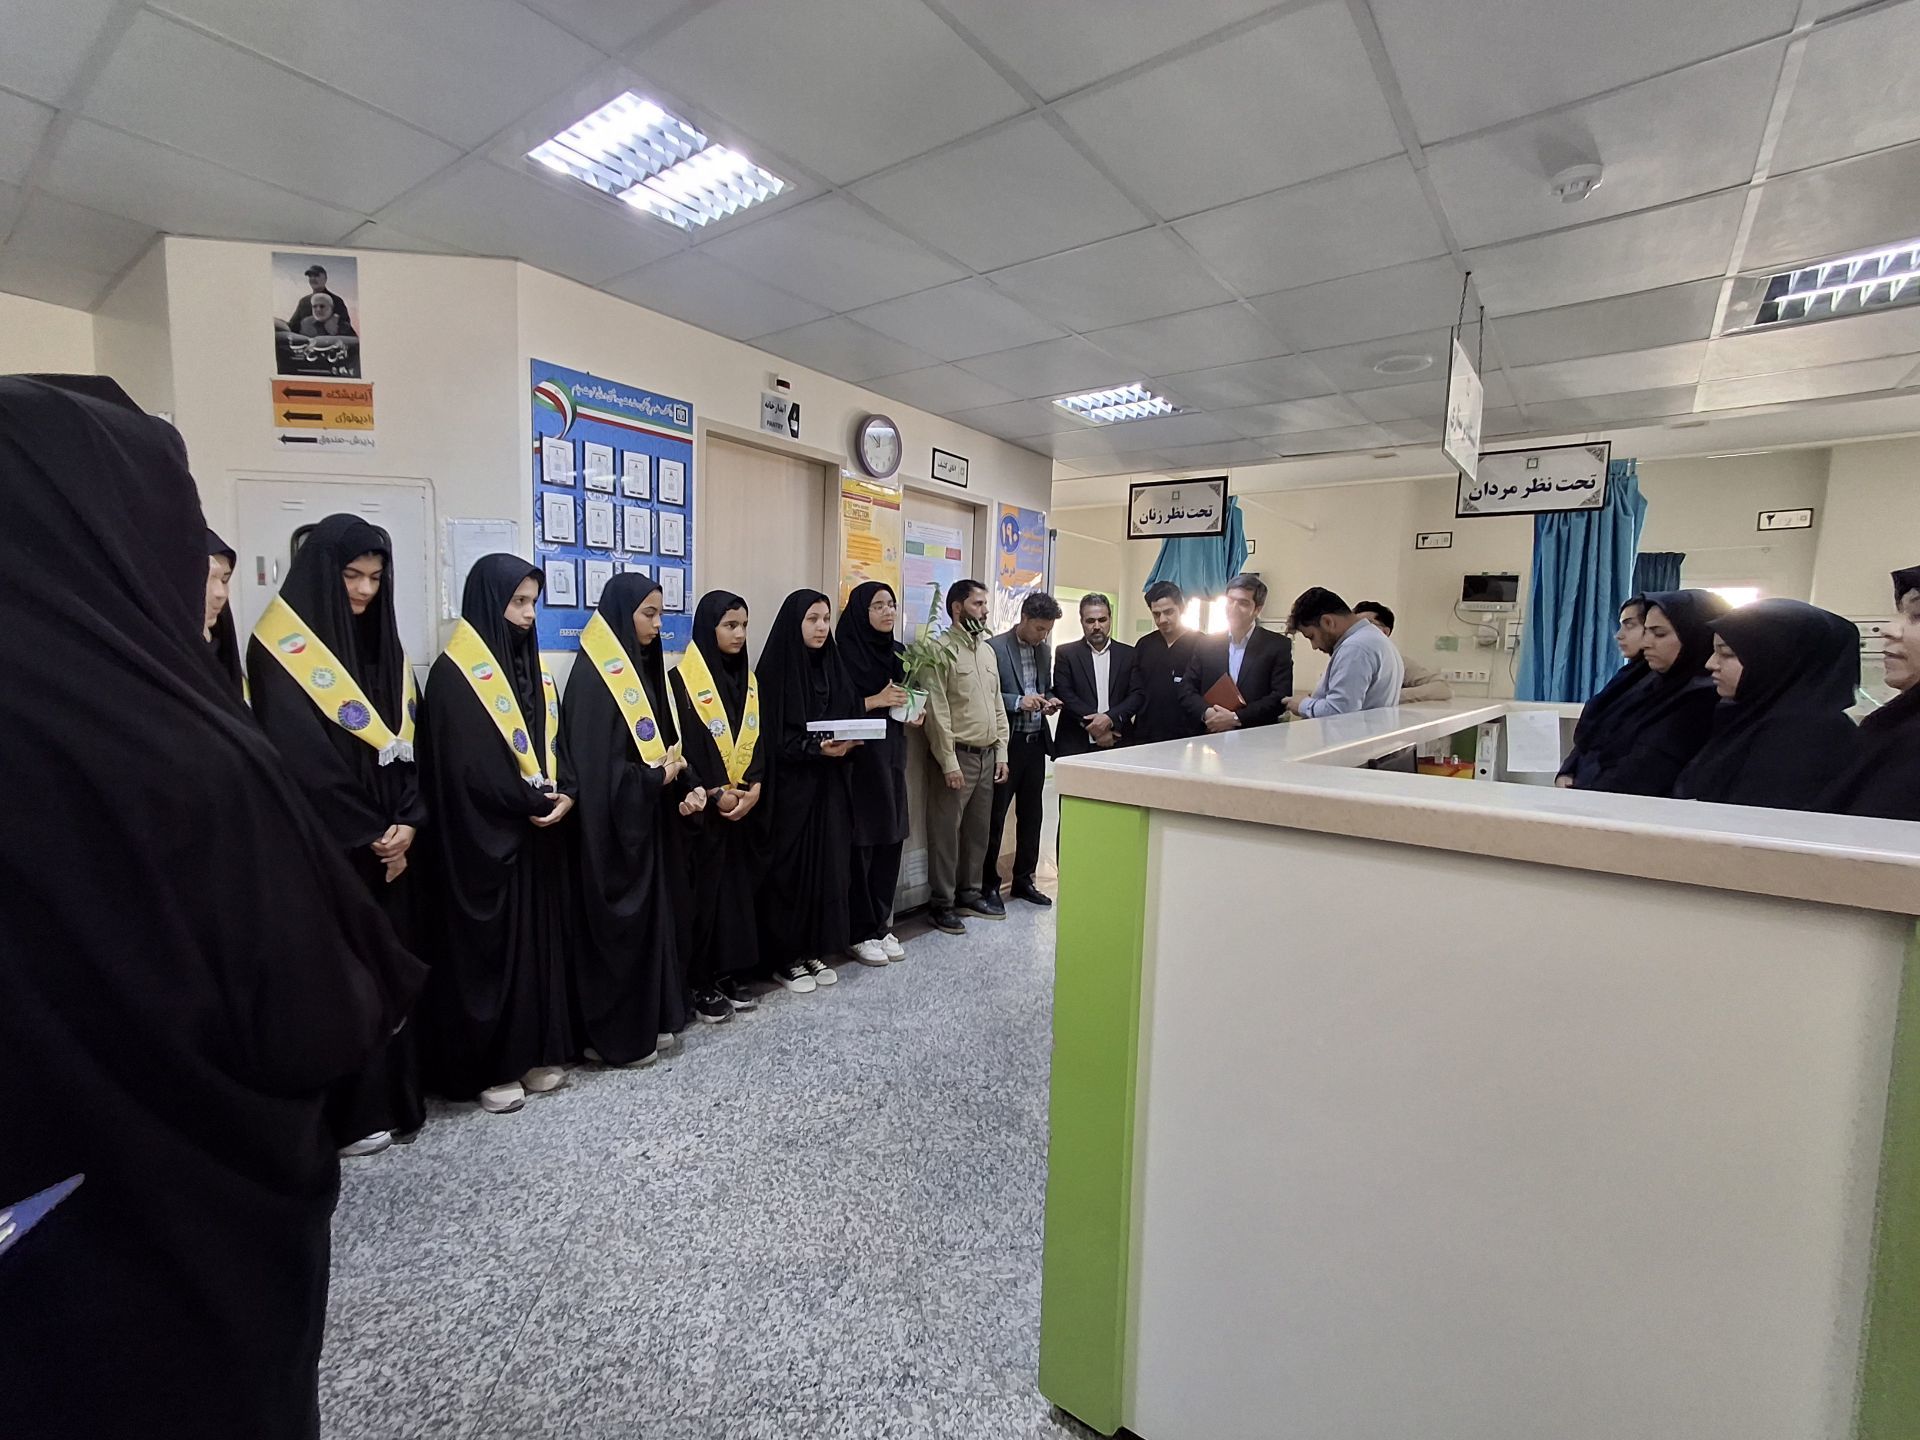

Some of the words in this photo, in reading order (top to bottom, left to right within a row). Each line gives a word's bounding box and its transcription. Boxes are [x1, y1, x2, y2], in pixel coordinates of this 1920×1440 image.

[766, 420, 783, 430] PANTRY
[1468, 481, 1518, 500] مردان
[1520, 477, 1552, 498] نظر
[1555, 474, 1597, 491] تحت
[1139, 507, 1163, 525] زنان
[1164, 506, 1185, 524] نظر
[1187, 504, 1213, 519] تحت
